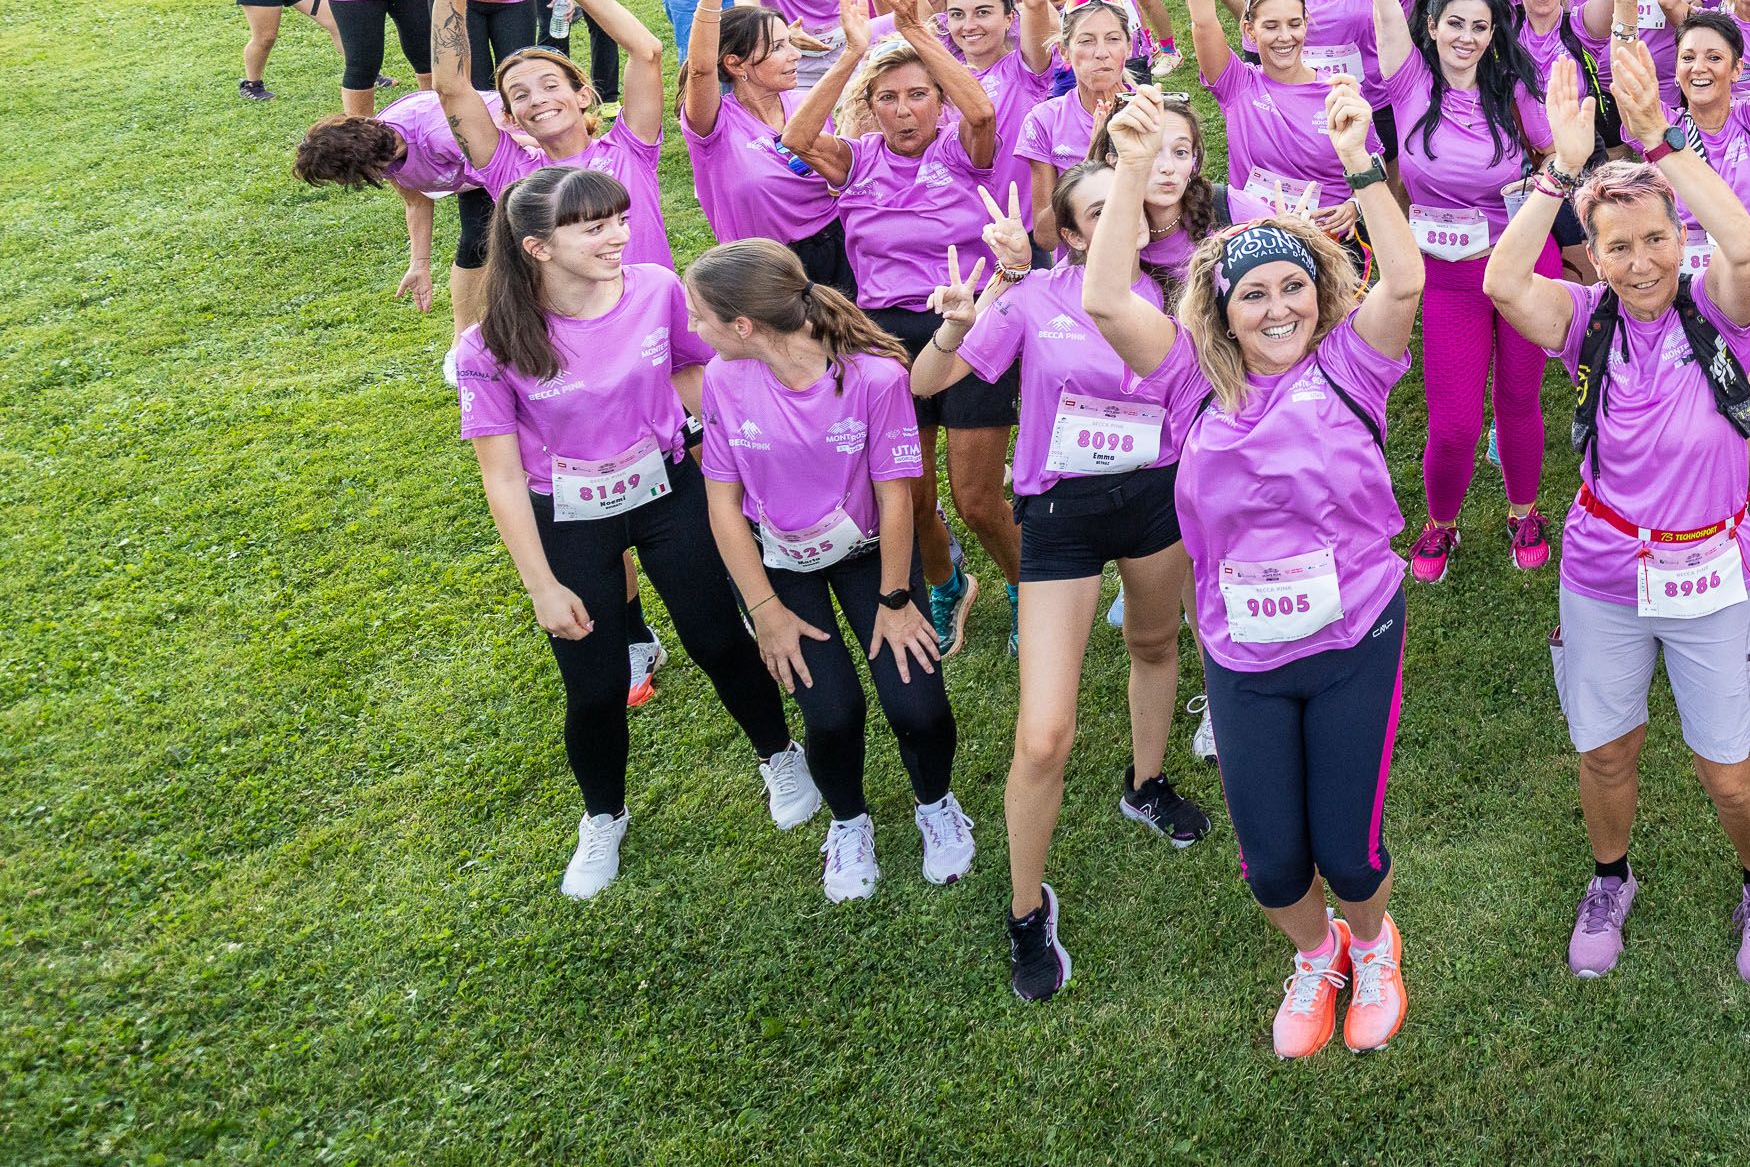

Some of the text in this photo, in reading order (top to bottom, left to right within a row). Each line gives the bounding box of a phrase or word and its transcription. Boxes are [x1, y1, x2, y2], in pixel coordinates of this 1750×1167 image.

[1637, 4, 1651, 15] 01
[1426, 230, 1469, 247] 8898
[1251, 248, 1287, 259] VALLE
[1690, 253, 1711, 268] 85
[1038, 330, 1086, 342] BECCA PINK
[528, 380, 585, 401] BECCA PINK
[728, 438, 771, 451] BECCA PINK
[1076, 429, 1135, 453] 8098
[1092, 452, 1115, 462] Emma
[579, 473, 641, 502] 8149
[599, 494, 627, 508] Noemi
[1675, 525, 1718, 541] TECHNOSPORT
[797, 556, 820, 567] Marta
[1664, 569, 1721, 598] 8986
[1246, 593, 1311, 618] 9005
